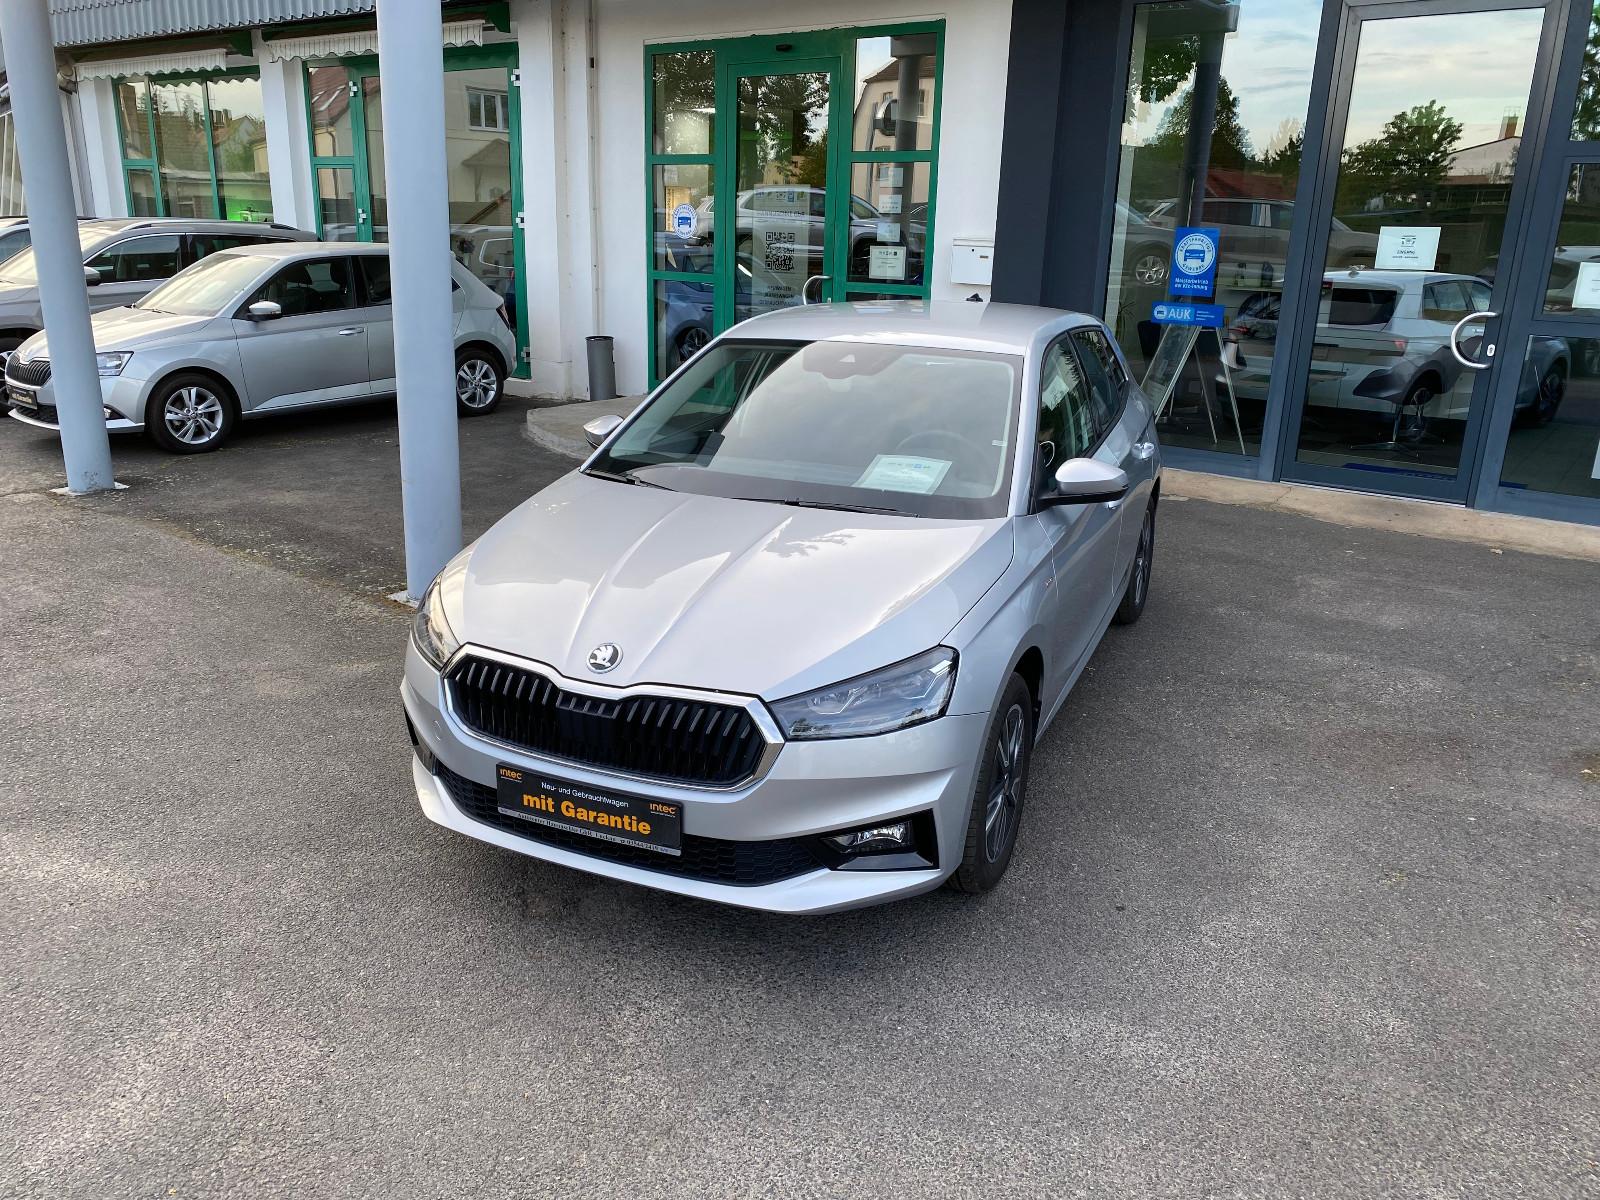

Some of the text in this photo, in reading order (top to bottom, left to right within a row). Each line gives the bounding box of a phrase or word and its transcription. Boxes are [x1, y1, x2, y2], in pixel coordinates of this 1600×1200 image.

[500, 768, 522, 780] intec
[541, 782, 629, 808] Neu- und Gebrauchtwagen
[523, 794, 652, 835] mit Garantie
[649, 803, 677, 815] intec
